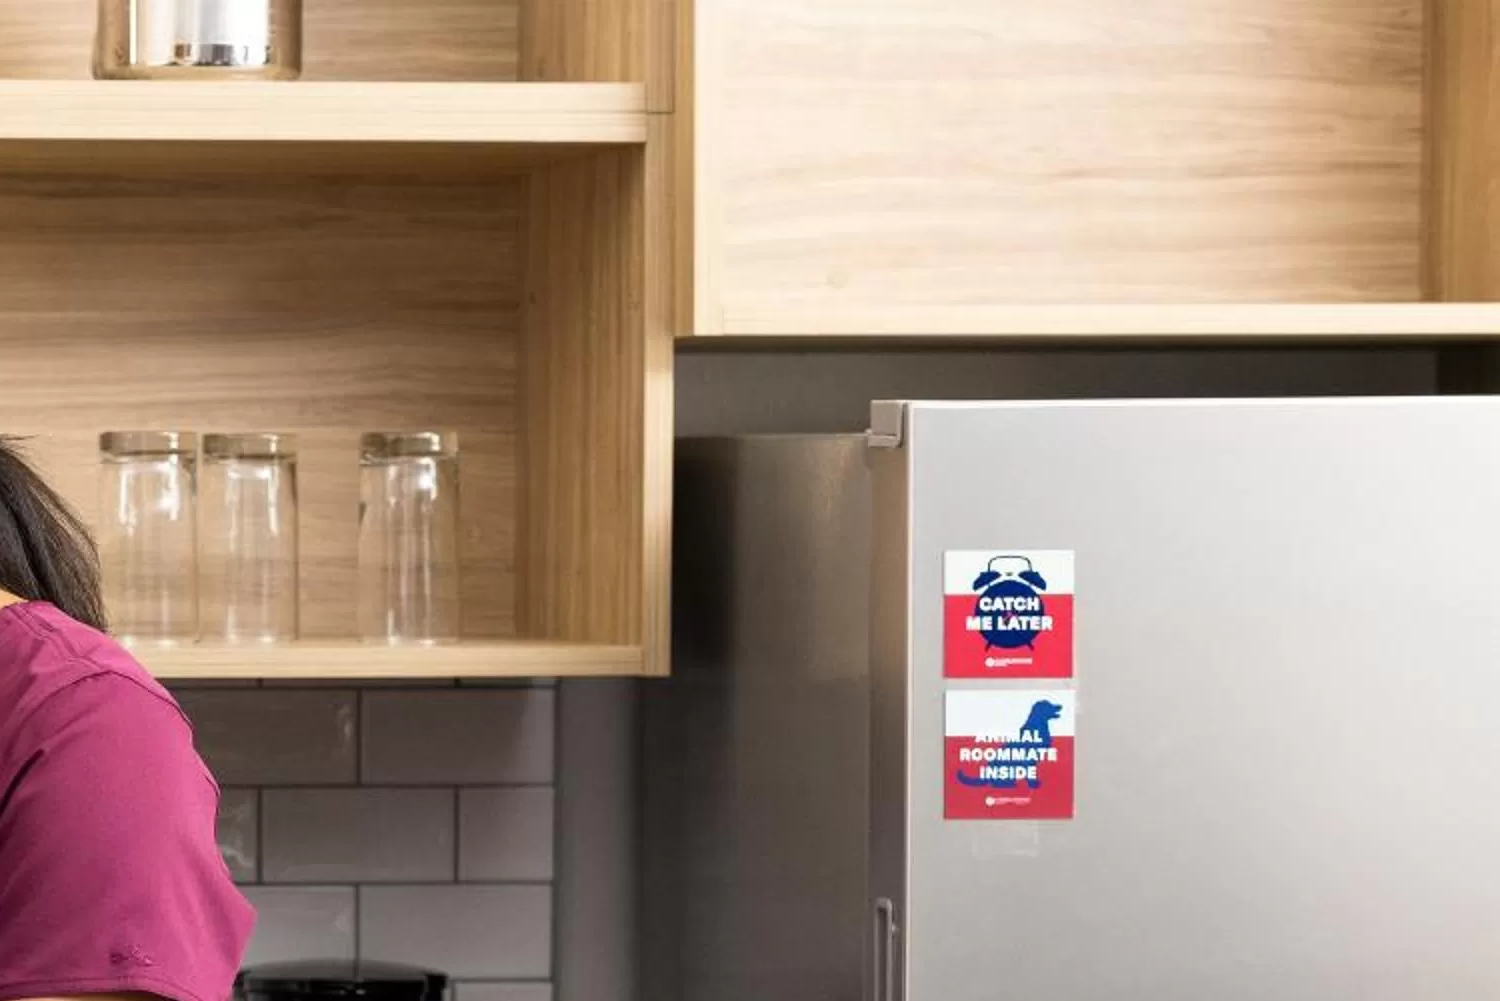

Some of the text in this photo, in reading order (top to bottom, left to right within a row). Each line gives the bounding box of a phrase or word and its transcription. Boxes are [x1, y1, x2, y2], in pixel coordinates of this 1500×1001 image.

[979, 596, 1040, 611] CATCH
[965, 616, 1053, 631] ME LATER
[959, 747, 1058, 761] ROOMMATE
[979, 766, 1038, 780] INSIDE
